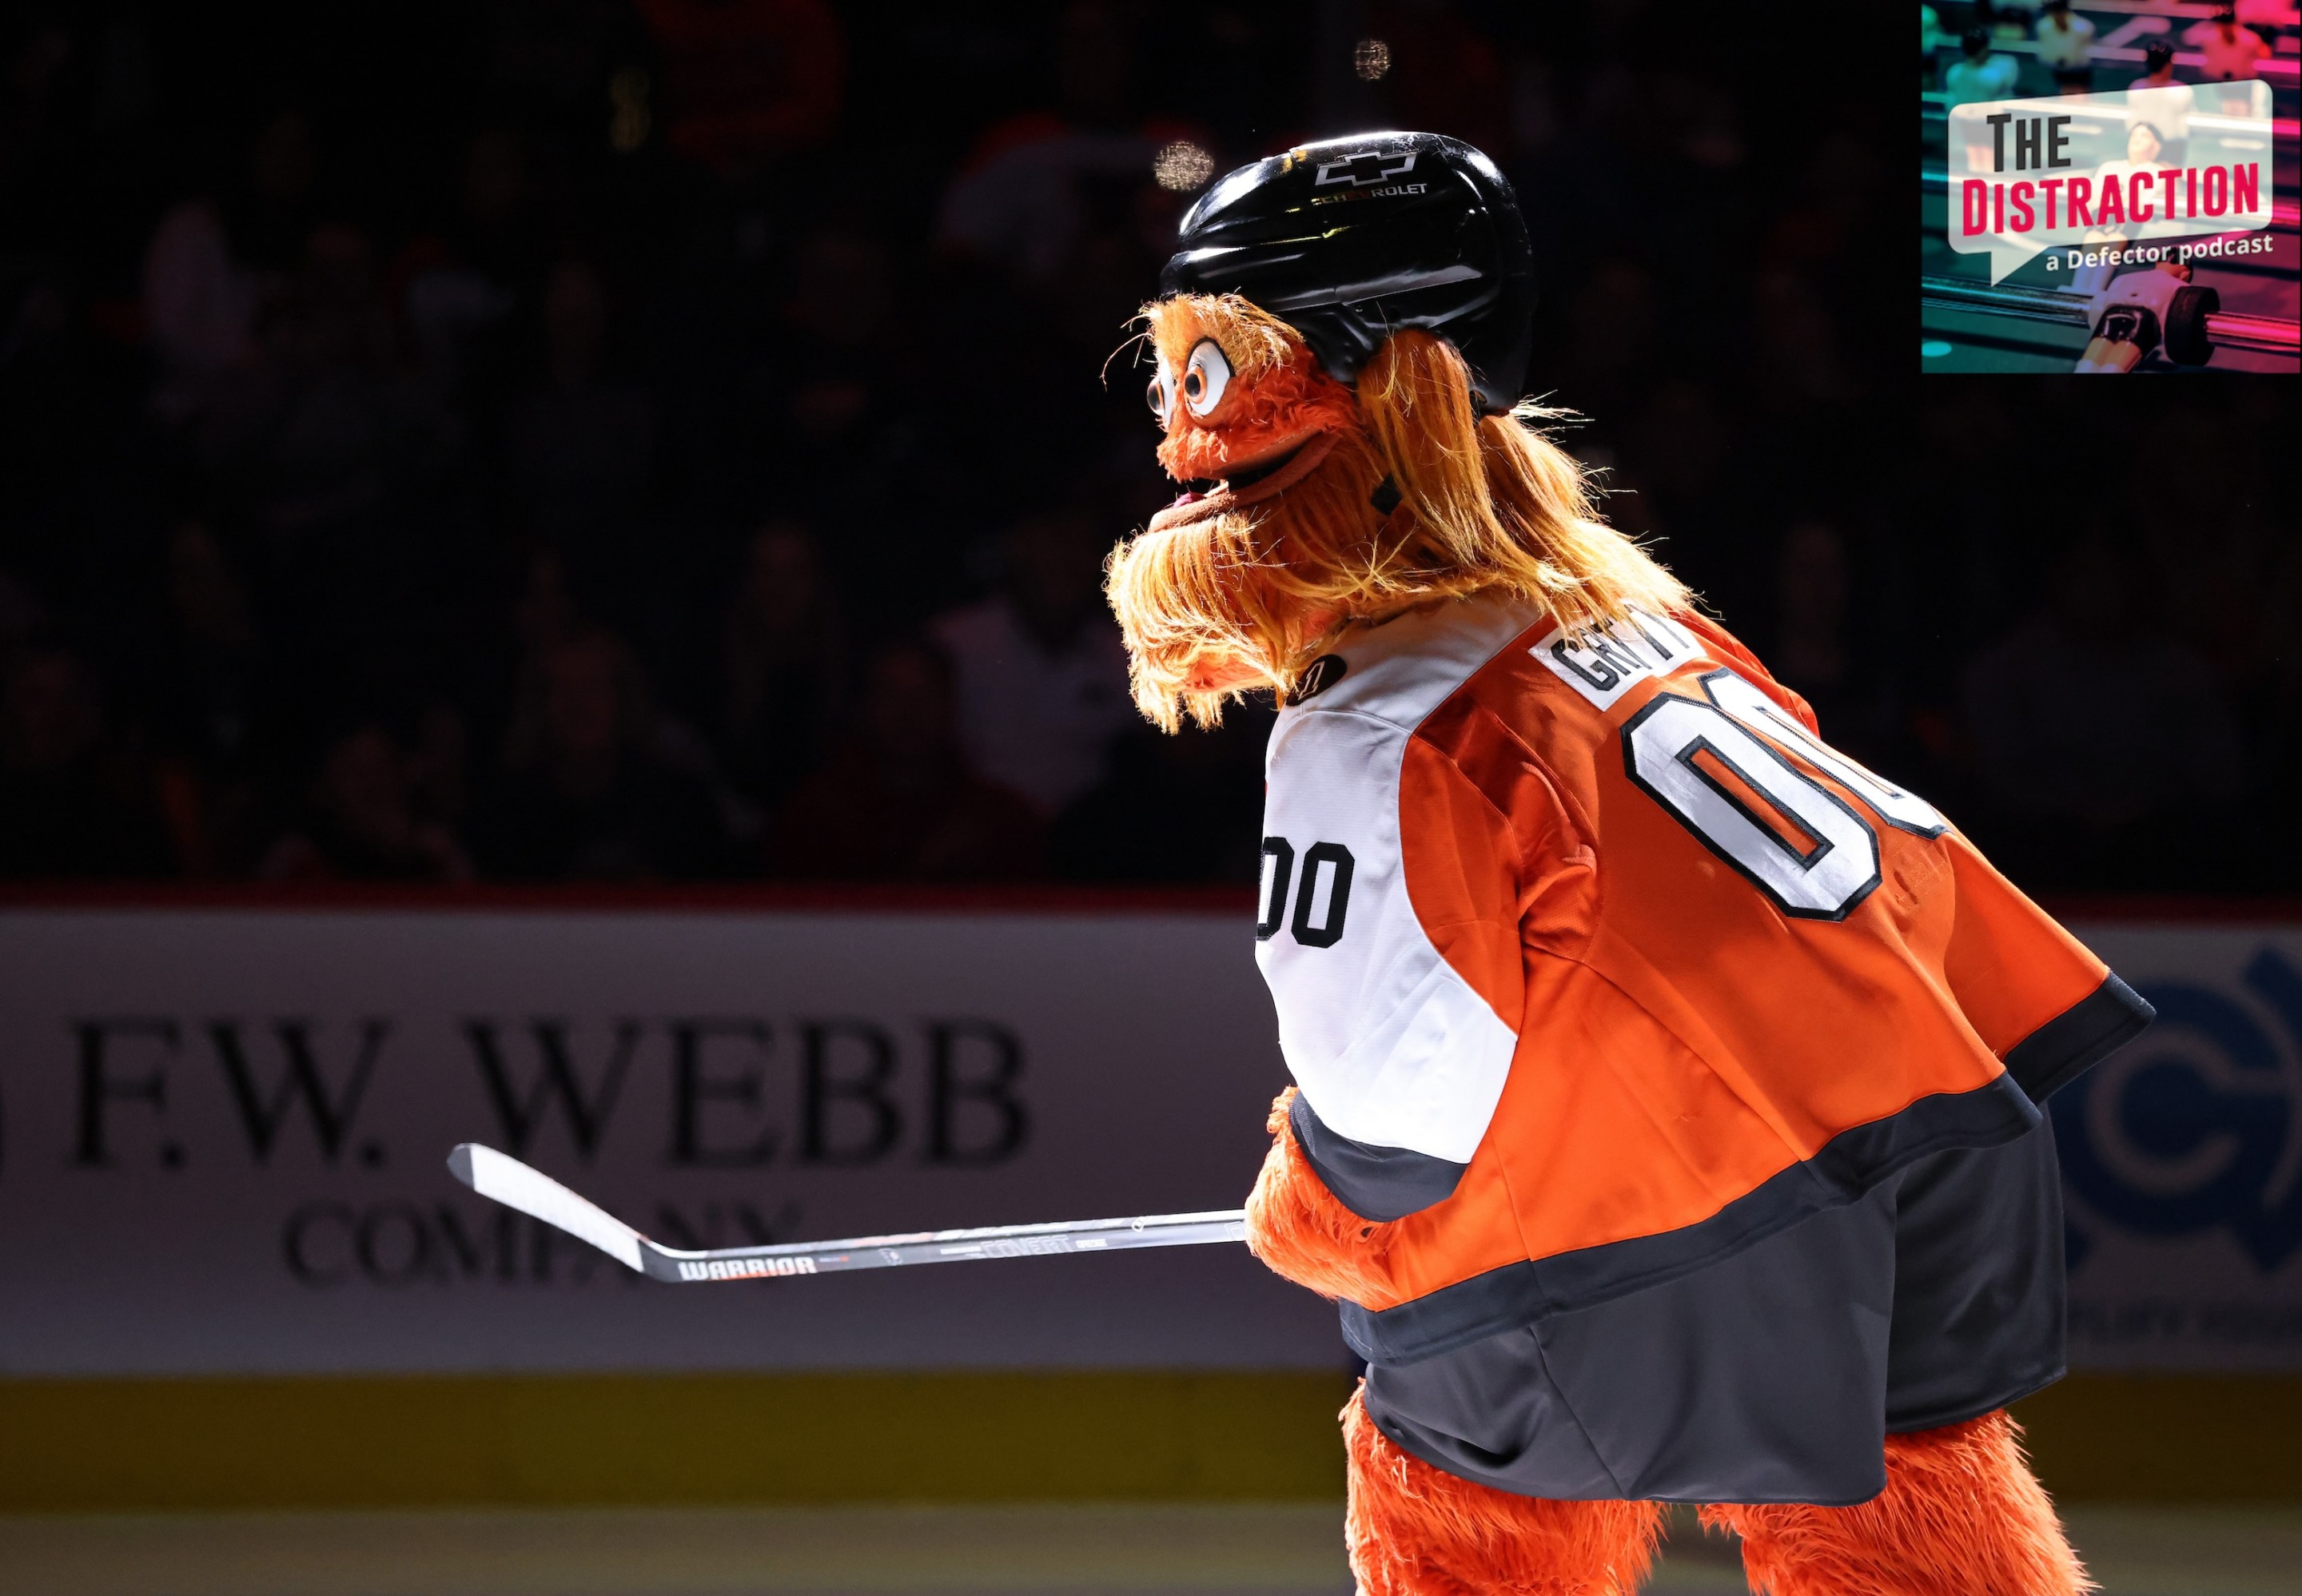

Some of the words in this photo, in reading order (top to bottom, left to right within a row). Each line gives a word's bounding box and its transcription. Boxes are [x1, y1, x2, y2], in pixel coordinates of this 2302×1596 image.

[1256, 837, 1356, 949] 00
[67, 1017, 387, 1168] F.W.
[456, 1016, 1030, 1168] WEBB
[678, 1256, 818, 1280] WARRIOR
